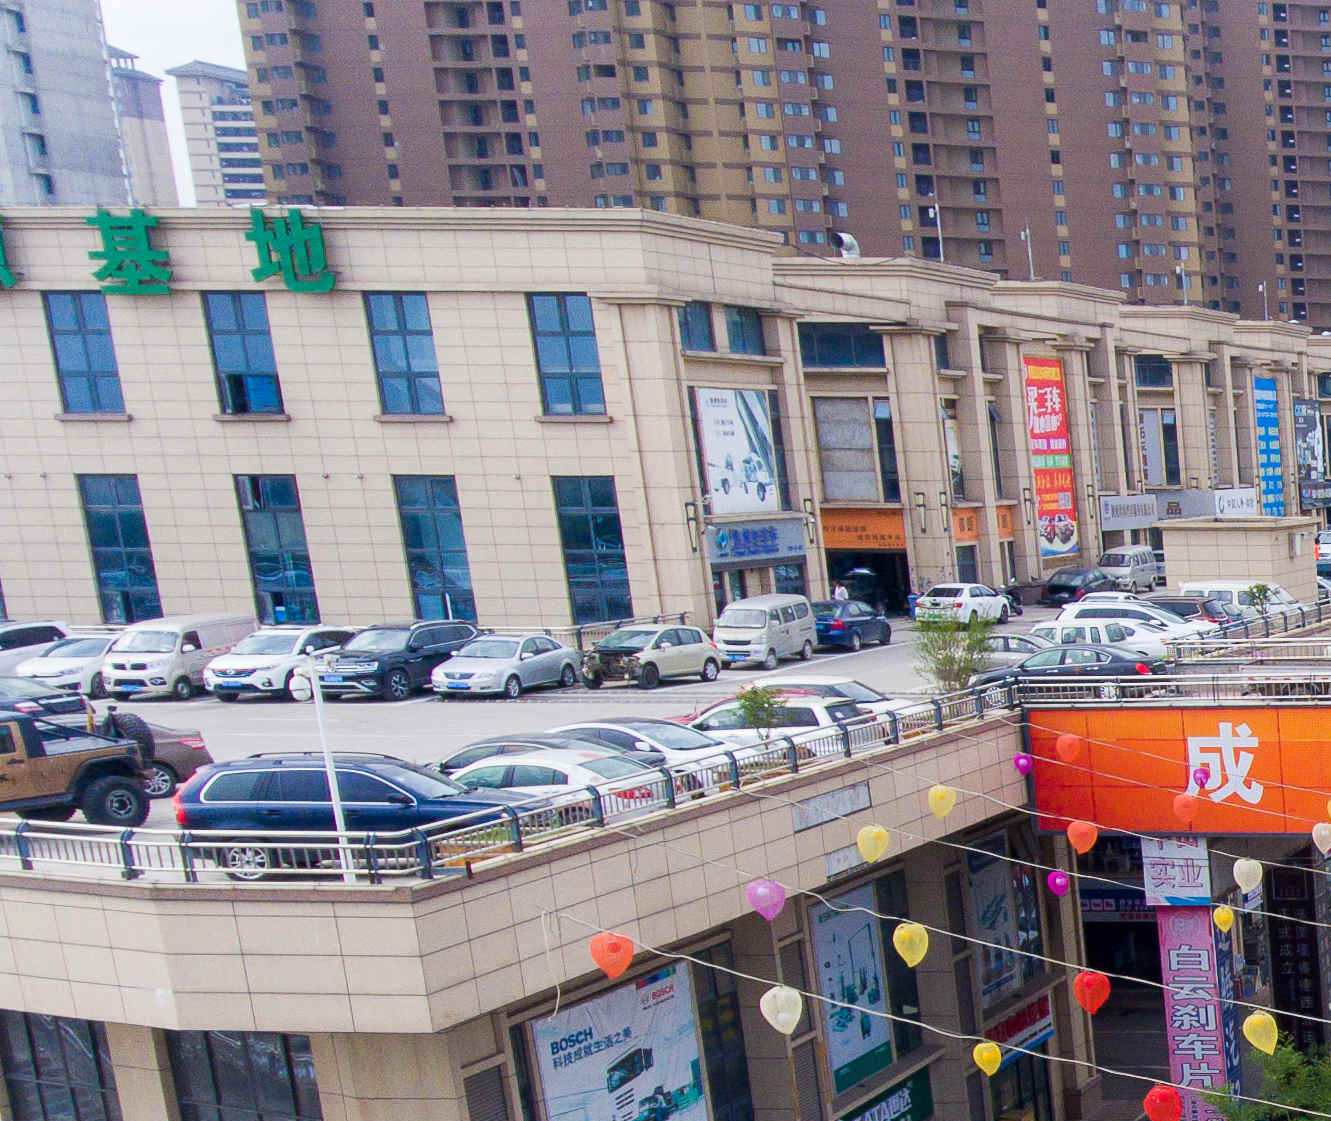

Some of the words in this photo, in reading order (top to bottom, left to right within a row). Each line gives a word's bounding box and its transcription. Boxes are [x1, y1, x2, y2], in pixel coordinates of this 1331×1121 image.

[0, 209, 336, 295] 基地
[1150, 858, 1204, 889] 实业
[550, 1026, 593, 1056] BOSCH
[1167, 943, 1222, 1090] 白云刹车片
